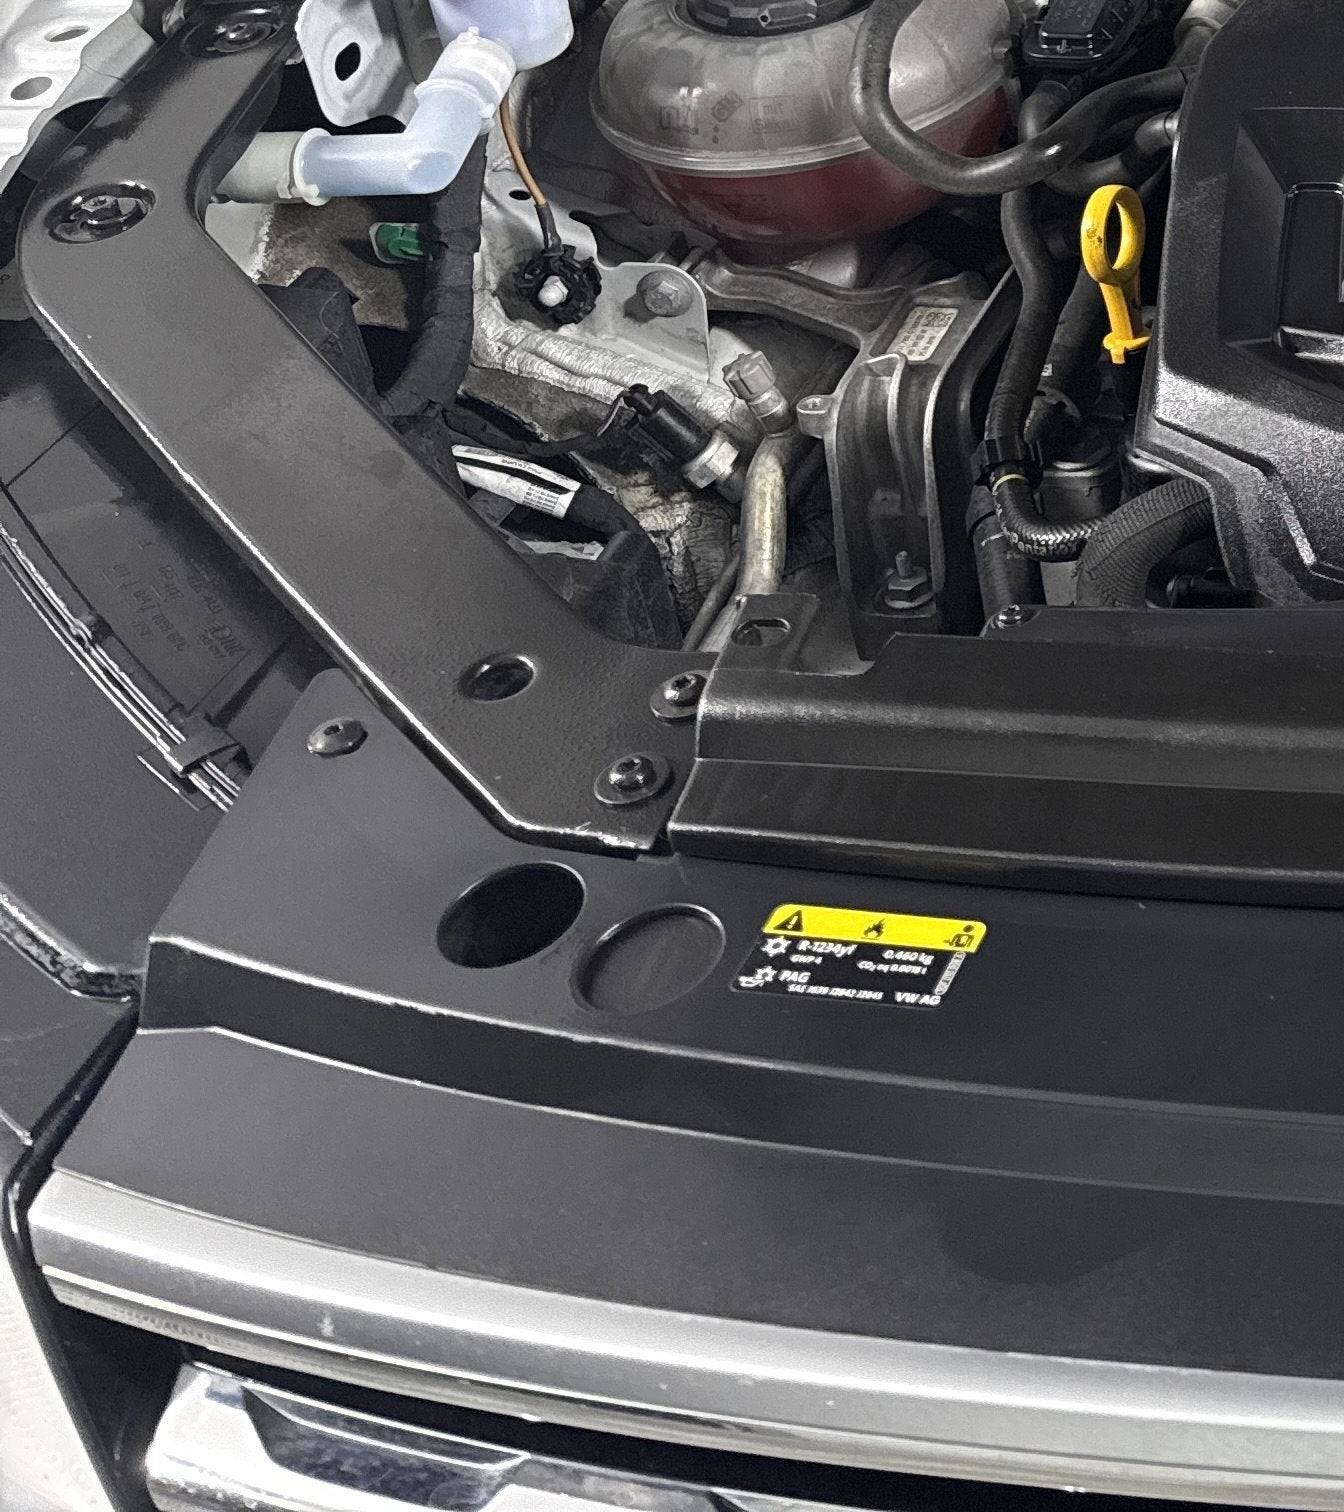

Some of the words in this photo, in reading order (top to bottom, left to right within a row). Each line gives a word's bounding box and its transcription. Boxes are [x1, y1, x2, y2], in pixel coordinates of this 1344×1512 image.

[797, 940, 857, 957] R-1234yf
[919, 953, 934, 965] kg
[779, 970, 811, 982] PAG
[895, 992, 920, 1003] VW
[919, 994, 940, 1005] AG
